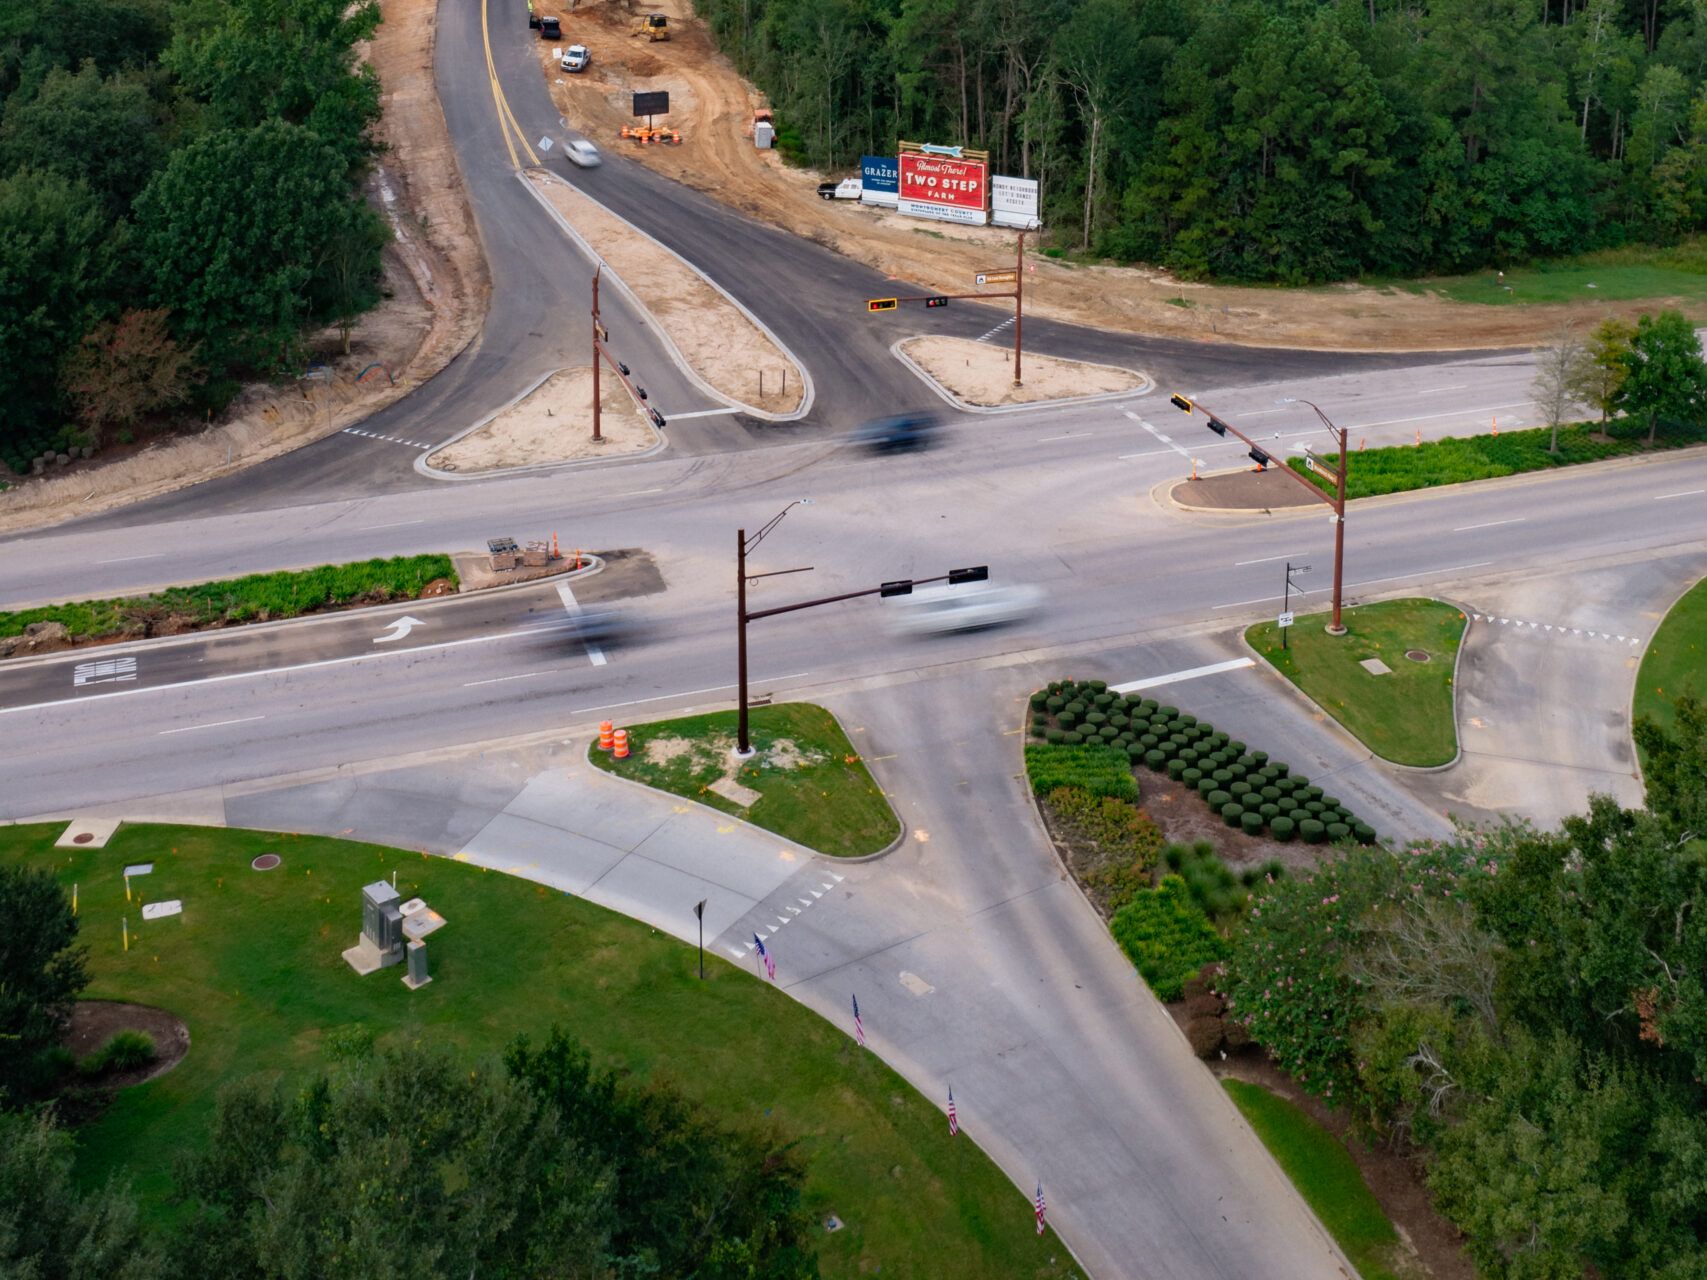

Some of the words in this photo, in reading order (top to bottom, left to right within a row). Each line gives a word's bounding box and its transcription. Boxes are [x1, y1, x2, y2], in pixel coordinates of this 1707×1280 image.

[864, 166, 898, 179] GRAZER
[916, 160, 941, 173] Almost
[941, 164, 967, 176] There!
[905, 172, 937, 187] TWO
[942, 178, 978, 193] STEP
[927, 190, 955, 200] FARM
